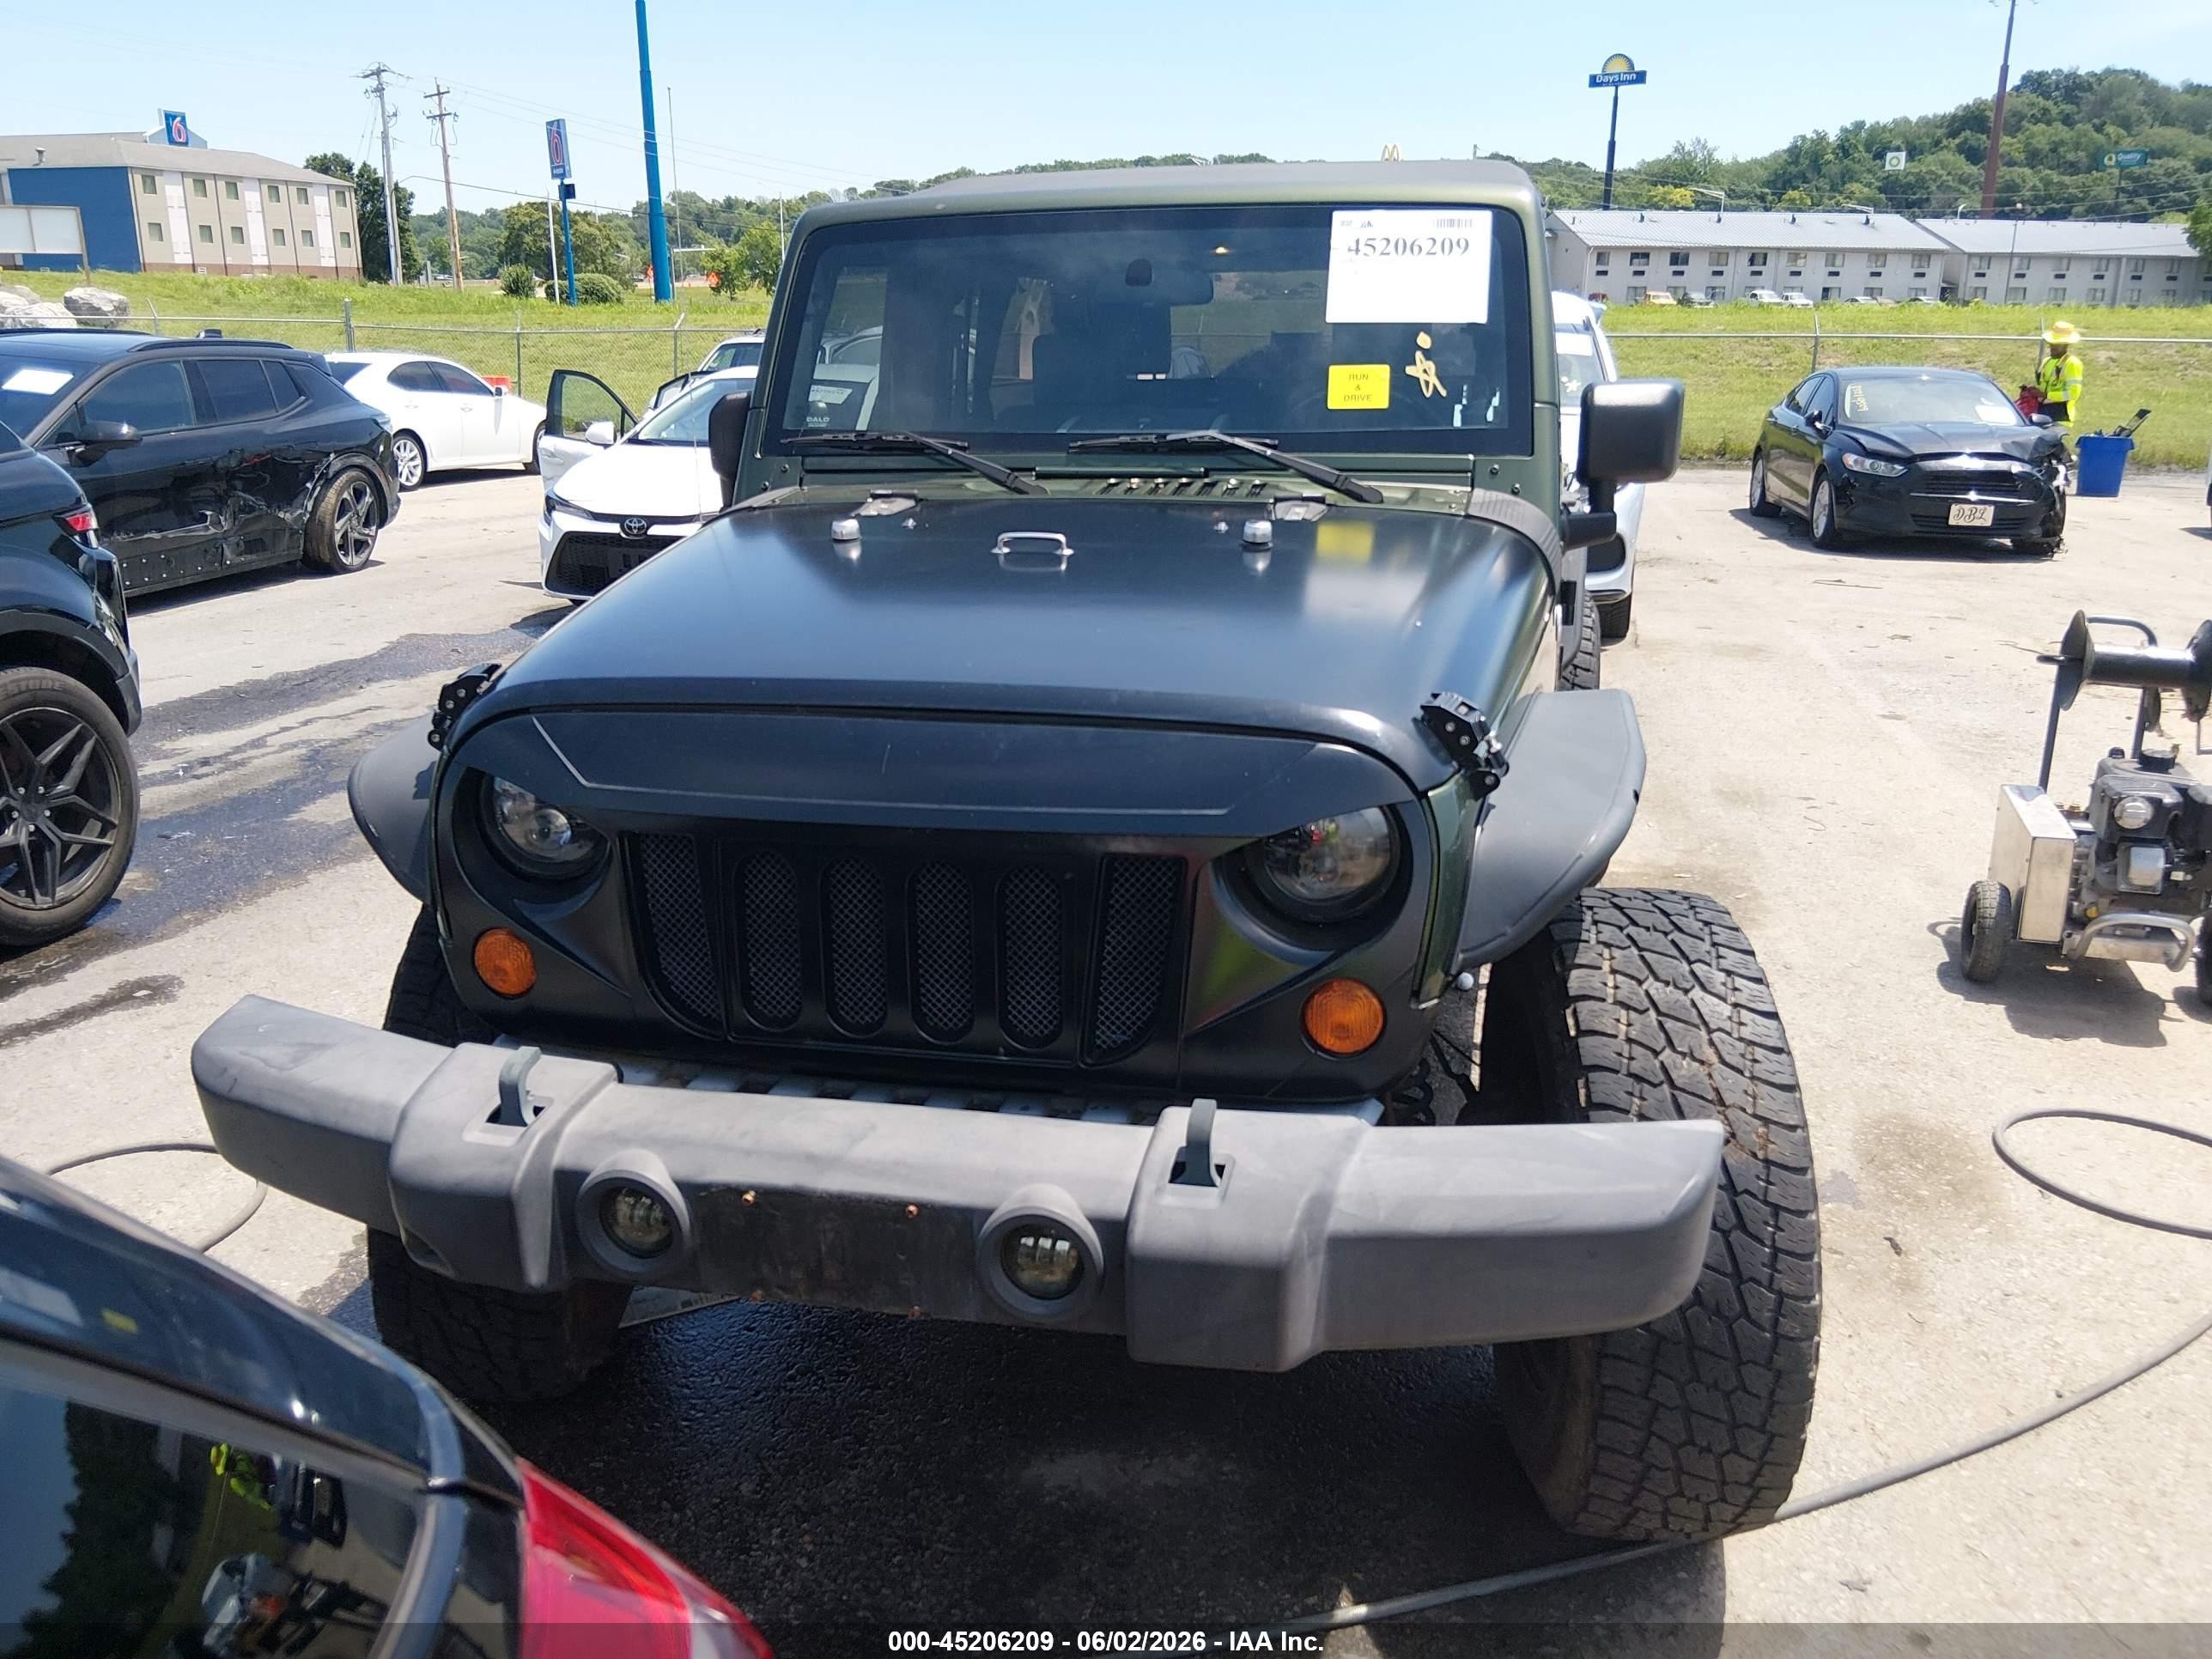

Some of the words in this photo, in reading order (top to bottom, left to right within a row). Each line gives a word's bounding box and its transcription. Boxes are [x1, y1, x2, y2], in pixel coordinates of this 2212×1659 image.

[1595, 74, 1620, 83] Days
[1620, 73, 1637, 82] Inn
[172, 116, 186, 143] 6
[550, 121, 563, 166] 6
[1347, 236, 1469, 257] 45206209
